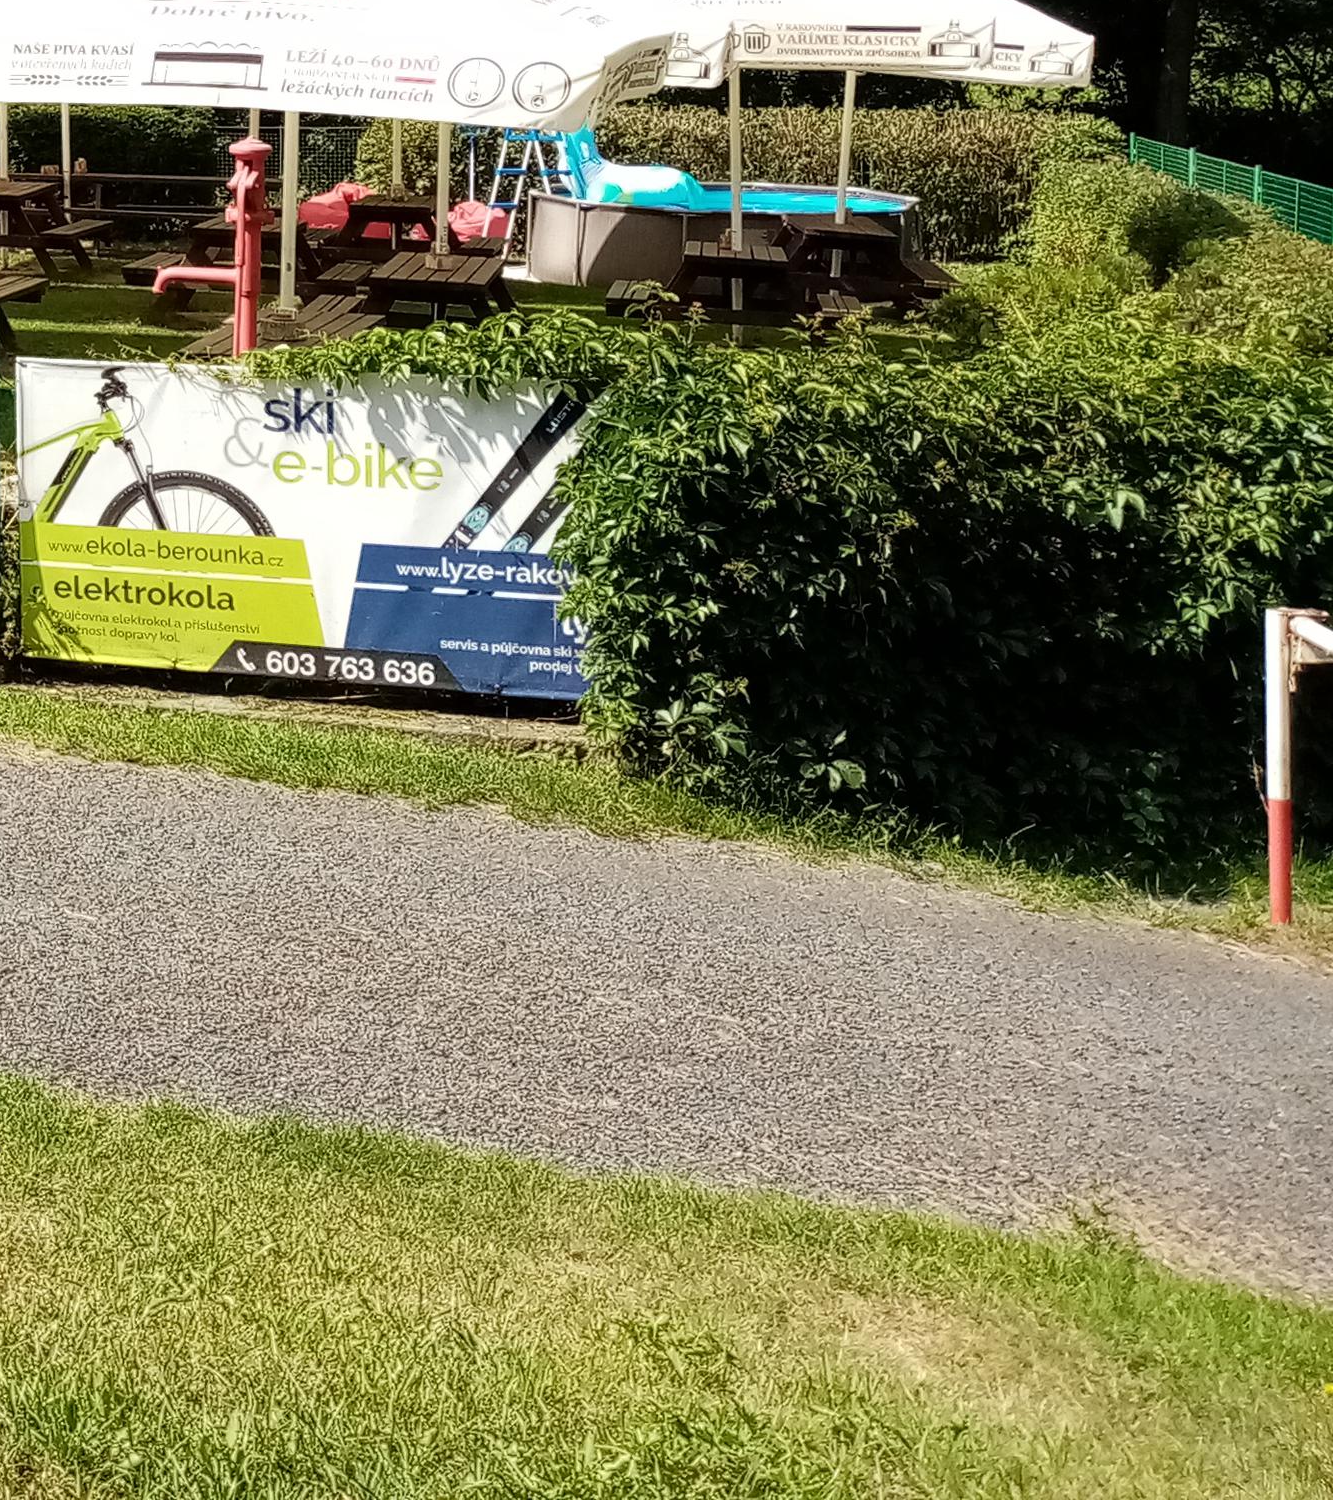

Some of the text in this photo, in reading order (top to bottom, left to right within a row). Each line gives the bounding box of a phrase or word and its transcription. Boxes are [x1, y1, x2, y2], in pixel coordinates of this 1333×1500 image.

[12, 42, 134, 56] NAŠE PIVA KVASÍ
[776, 32, 920, 47] VAŘÍME KLASICKY
[286, 48, 328, 64] LEŽÍ
[399, 55, 440, 72] DNŮ
[281, 78, 434, 103] ležáckých tancích
[263, 387, 334, 434] ski
[224, 417, 443, 491] & e-bike
[48, 536, 284, 567] www.ekola-berounka.cz
[396, 556, 578, 585] www.lyze-rakov
[53, 575, 235, 611] elektrokola
[110, 627, 157, 644] dopravy
[112, 613, 172, 630] elektrokol
[174, 620, 182, 629] a
[184, 619, 261, 635] příslušenství
[439, 638, 478, 651] servis
[480, 642, 489, 652] a
[491, 641, 551, 657] půjčovna
[553, 645, 572, 657] ski
[266, 650, 435, 686] 603 763 636
[529, 659, 573, 675] prodej
